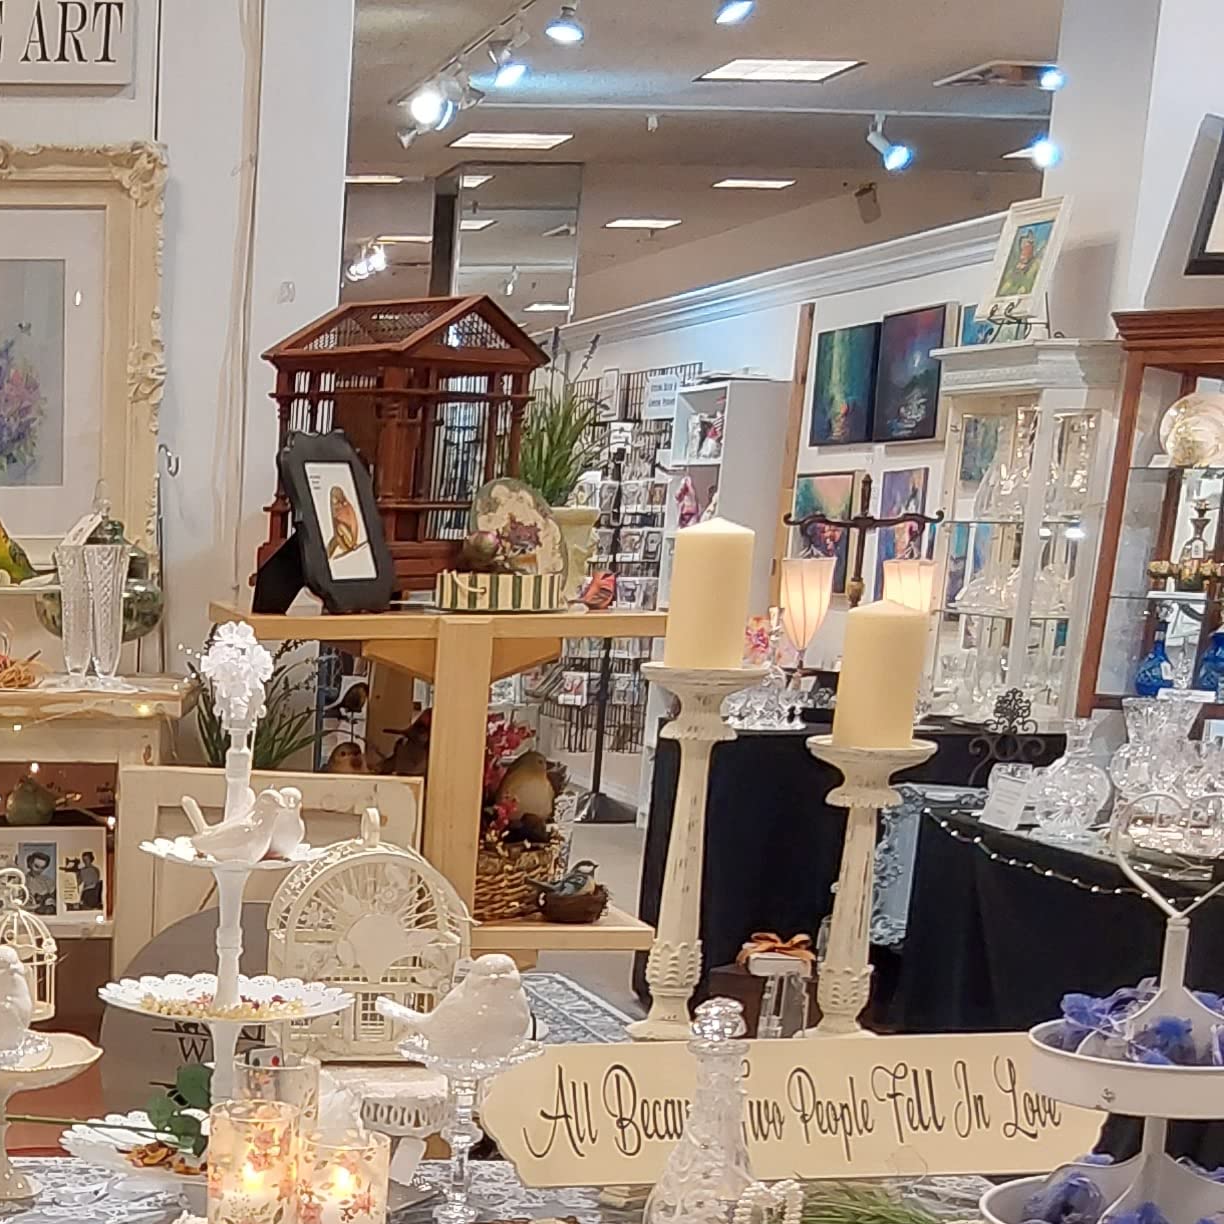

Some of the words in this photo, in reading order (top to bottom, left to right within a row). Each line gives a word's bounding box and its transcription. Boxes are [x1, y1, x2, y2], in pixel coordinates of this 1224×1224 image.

[19, 0, 123, 62] ART
[523, 1064, 598, 1158] All
[602, 1064, 691, 1157] Becau
[787, 1067, 874, 1161] People
[871, 1062, 944, 1143] Fell
[954, 1060, 990, 1138] In
[994, 1056, 1061, 1138] Love
